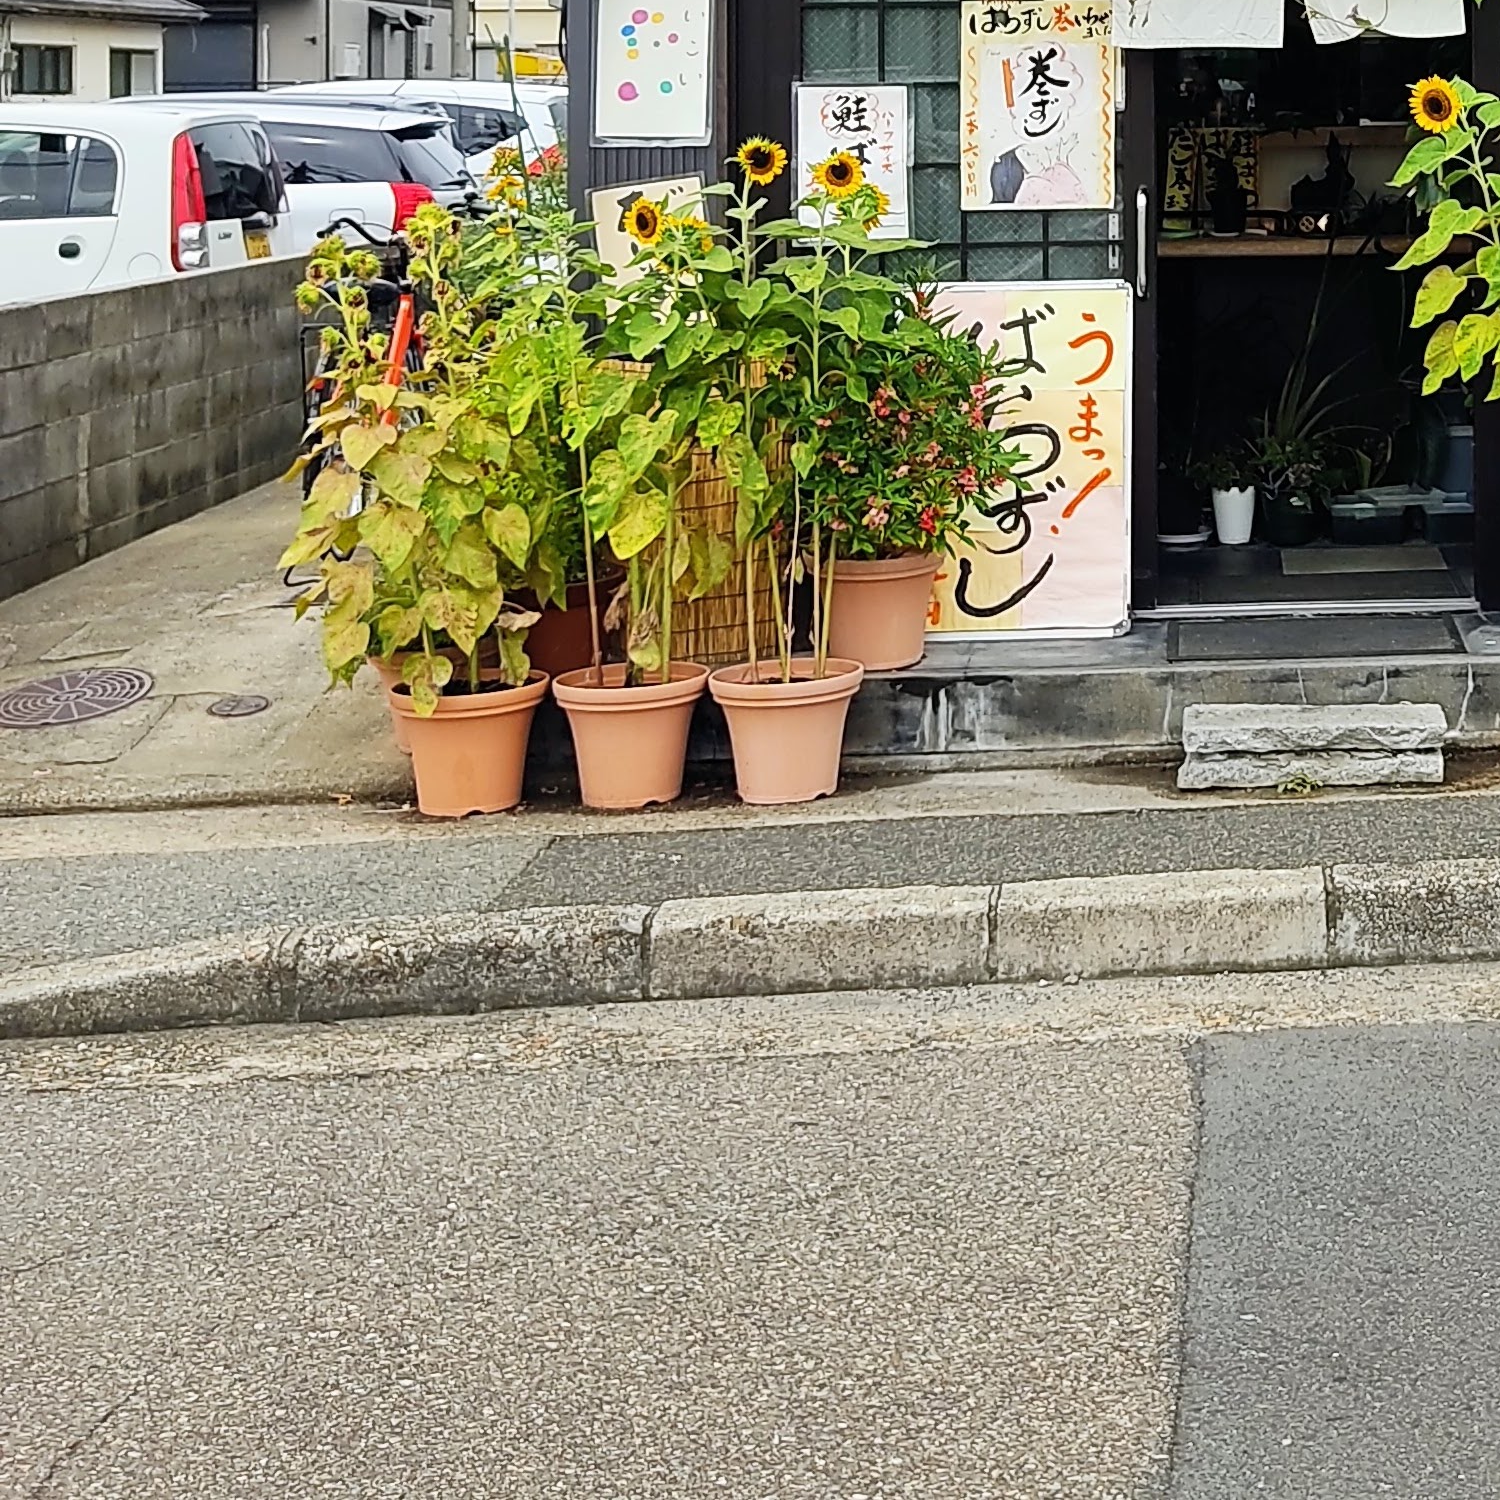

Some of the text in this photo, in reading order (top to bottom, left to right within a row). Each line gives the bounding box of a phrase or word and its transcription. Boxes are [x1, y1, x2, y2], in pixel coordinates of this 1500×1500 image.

[1018, 47, 1070, 137] 巻ずし
[955, 303, 1066, 618] ばらずし
